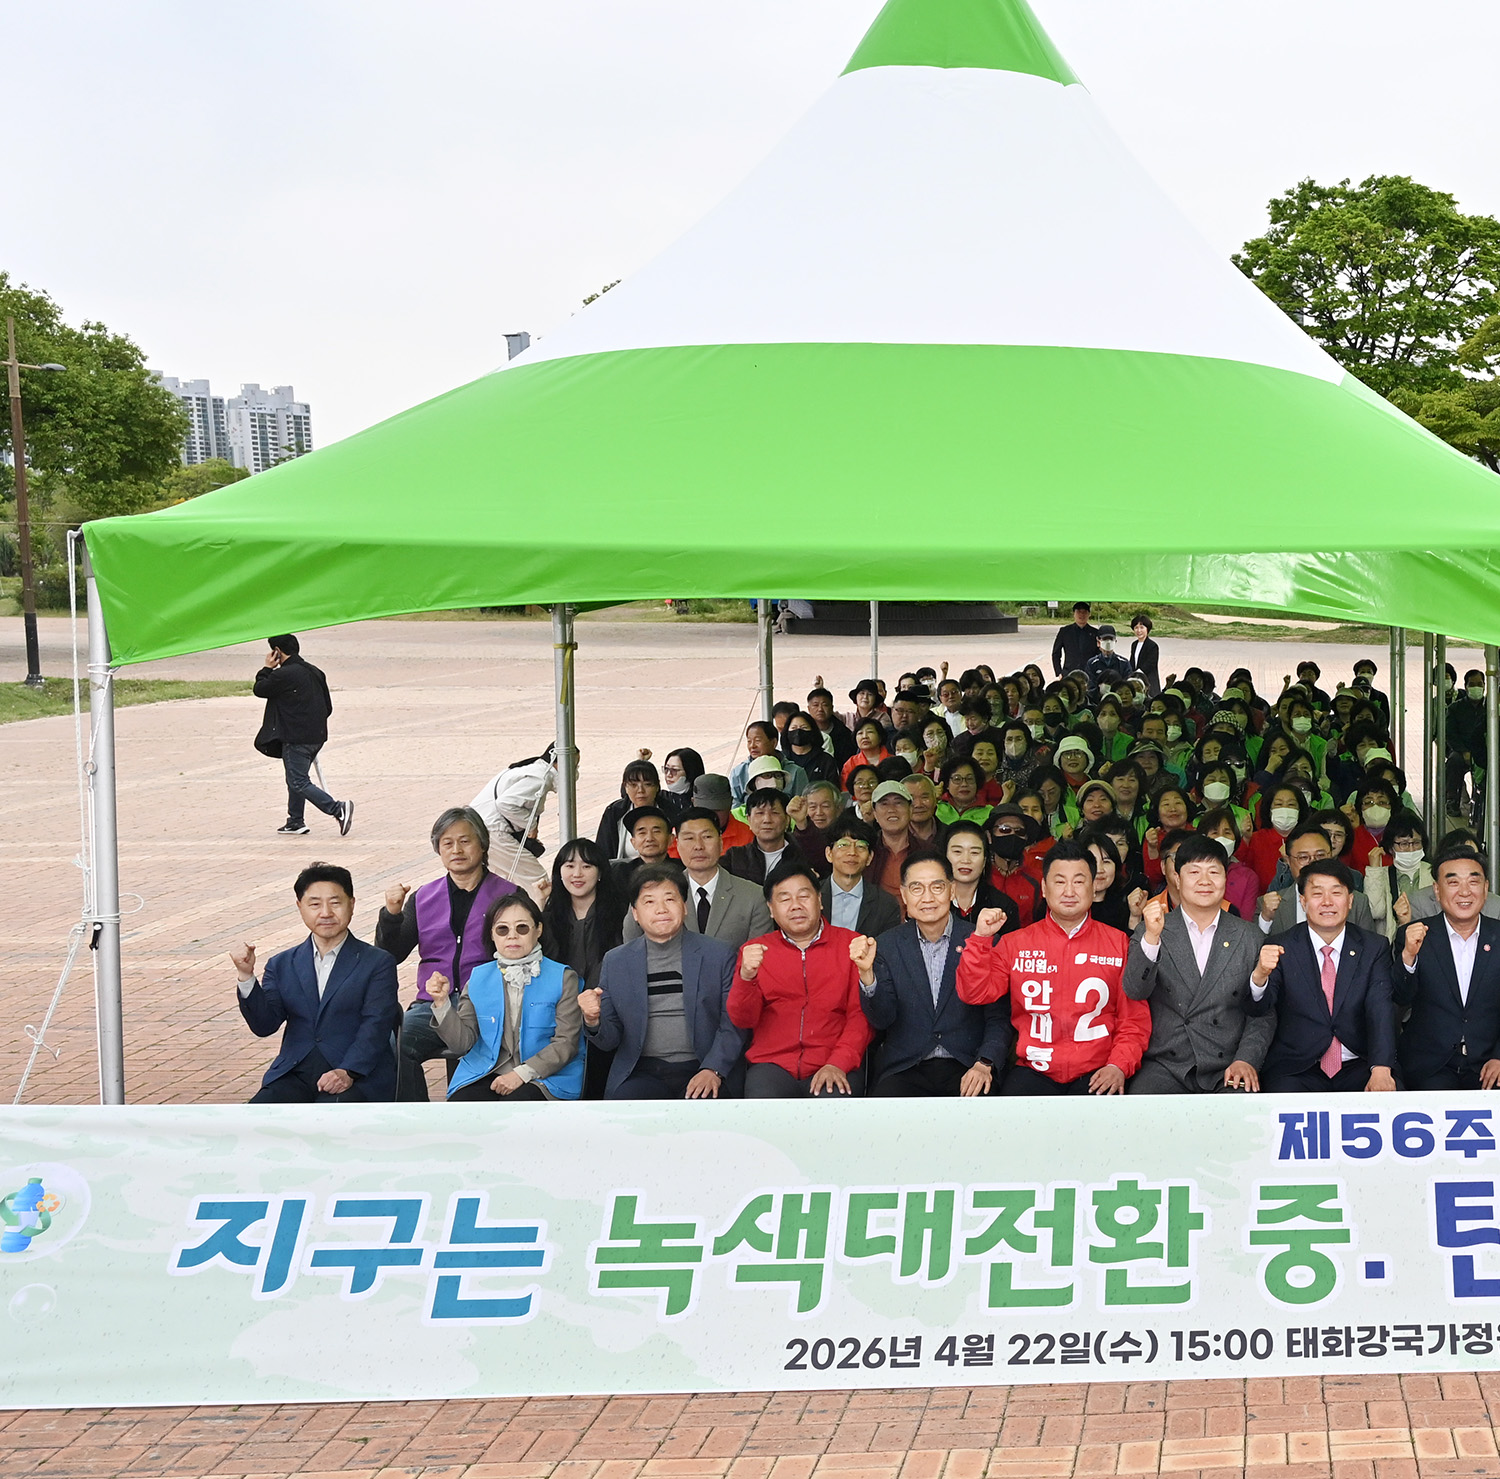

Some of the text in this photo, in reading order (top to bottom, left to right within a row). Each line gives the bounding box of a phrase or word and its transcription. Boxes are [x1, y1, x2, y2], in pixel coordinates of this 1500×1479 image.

[1073, 977, 1110, 1042] 2
[176, 1197, 545, 1319] 지구는
[595, 1180, 1204, 1316] 녹색대전환
[1249, 1184, 1386, 1304] 중.
[783, 1335, 922, 1371] 2026년
[934, 1334, 997, 1368] 4월
[1007, 1329, 1159, 1367] 22일(수)
[1170, 1328, 1274, 1362] 15:00
